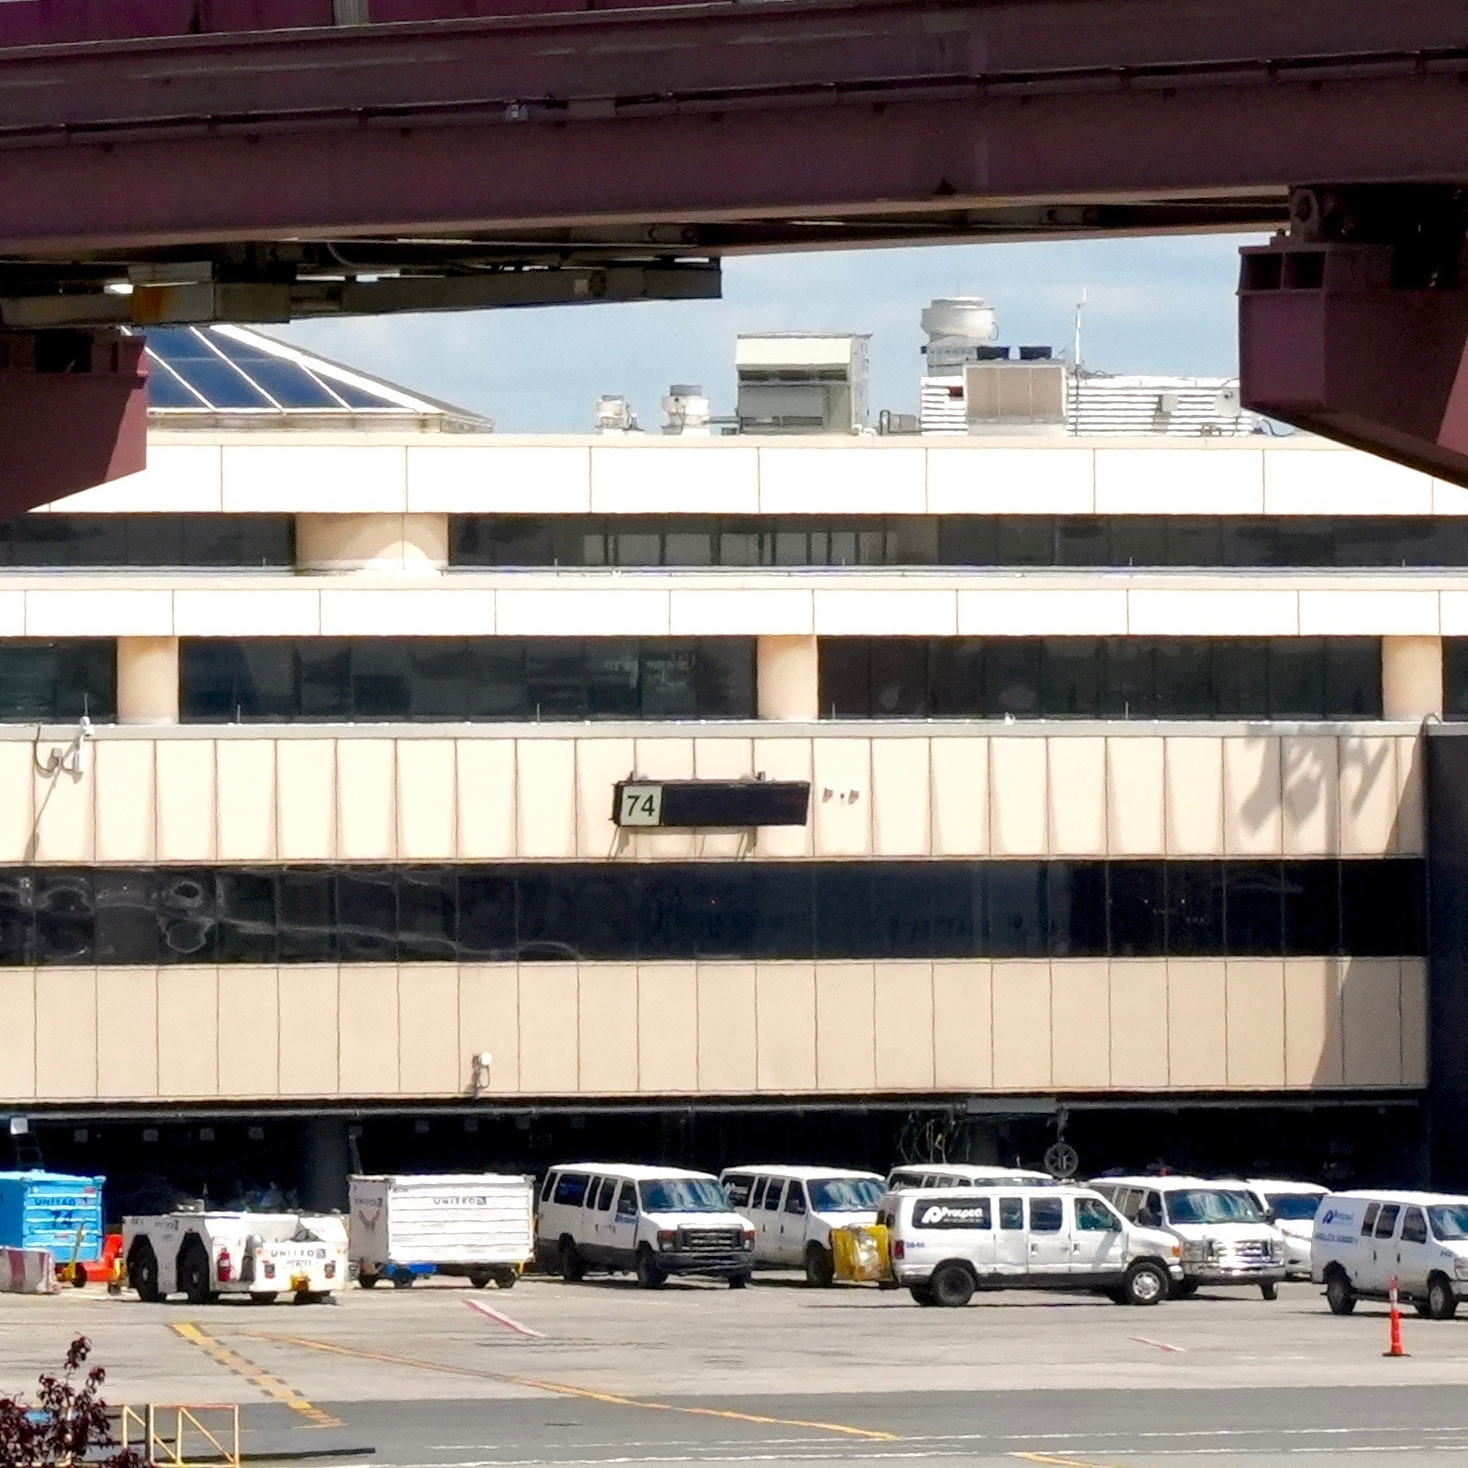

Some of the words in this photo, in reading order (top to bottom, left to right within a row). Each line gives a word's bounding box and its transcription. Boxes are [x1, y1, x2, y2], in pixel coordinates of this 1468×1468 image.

[627, 794, 655, 817] 74
[34, 1198, 76, 1206] UNITED
[434, 1197, 477, 1205] UNITED
[51, 1210, 73, 1228] 74
